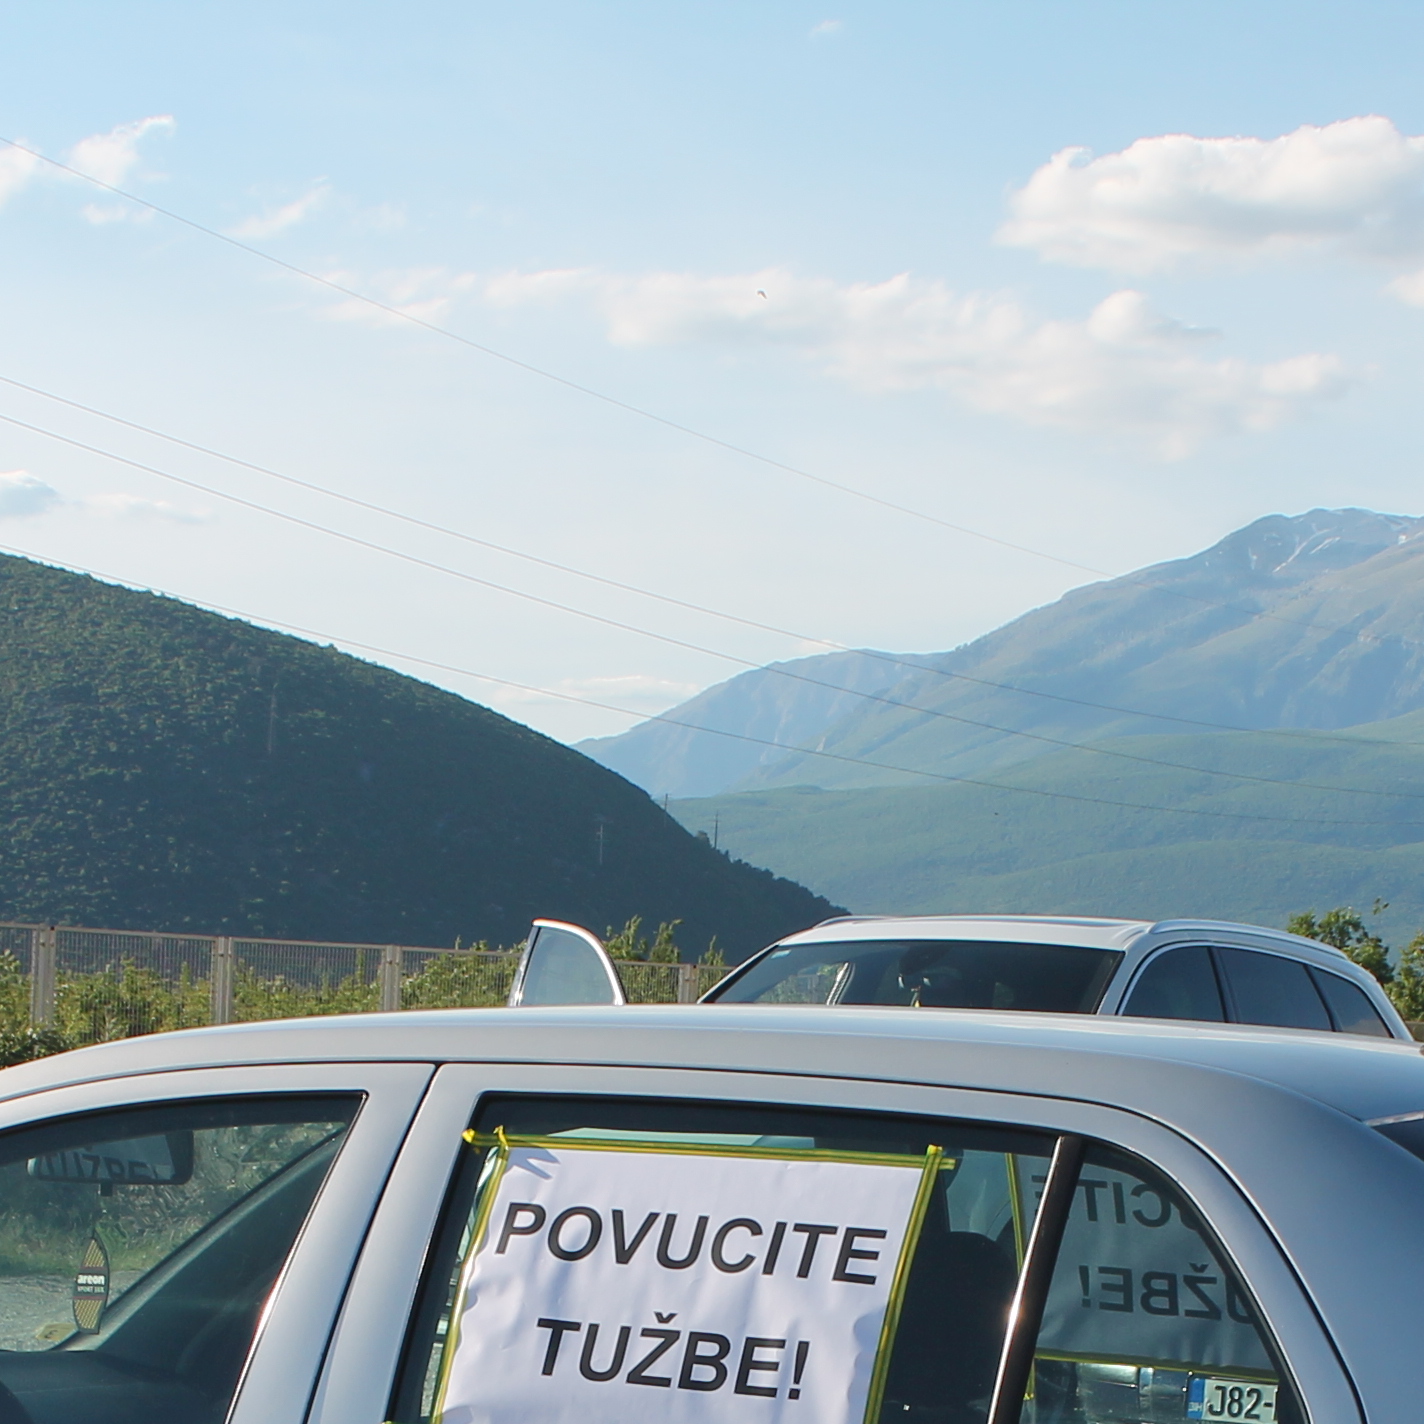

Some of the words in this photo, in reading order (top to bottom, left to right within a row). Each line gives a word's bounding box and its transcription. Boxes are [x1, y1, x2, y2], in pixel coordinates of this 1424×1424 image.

[494, 1202, 887, 1285] POVUCITE
[537, 1311, 810, 1400] TUŽBE!
[1208, 1385, 1279, 1421] J82-
